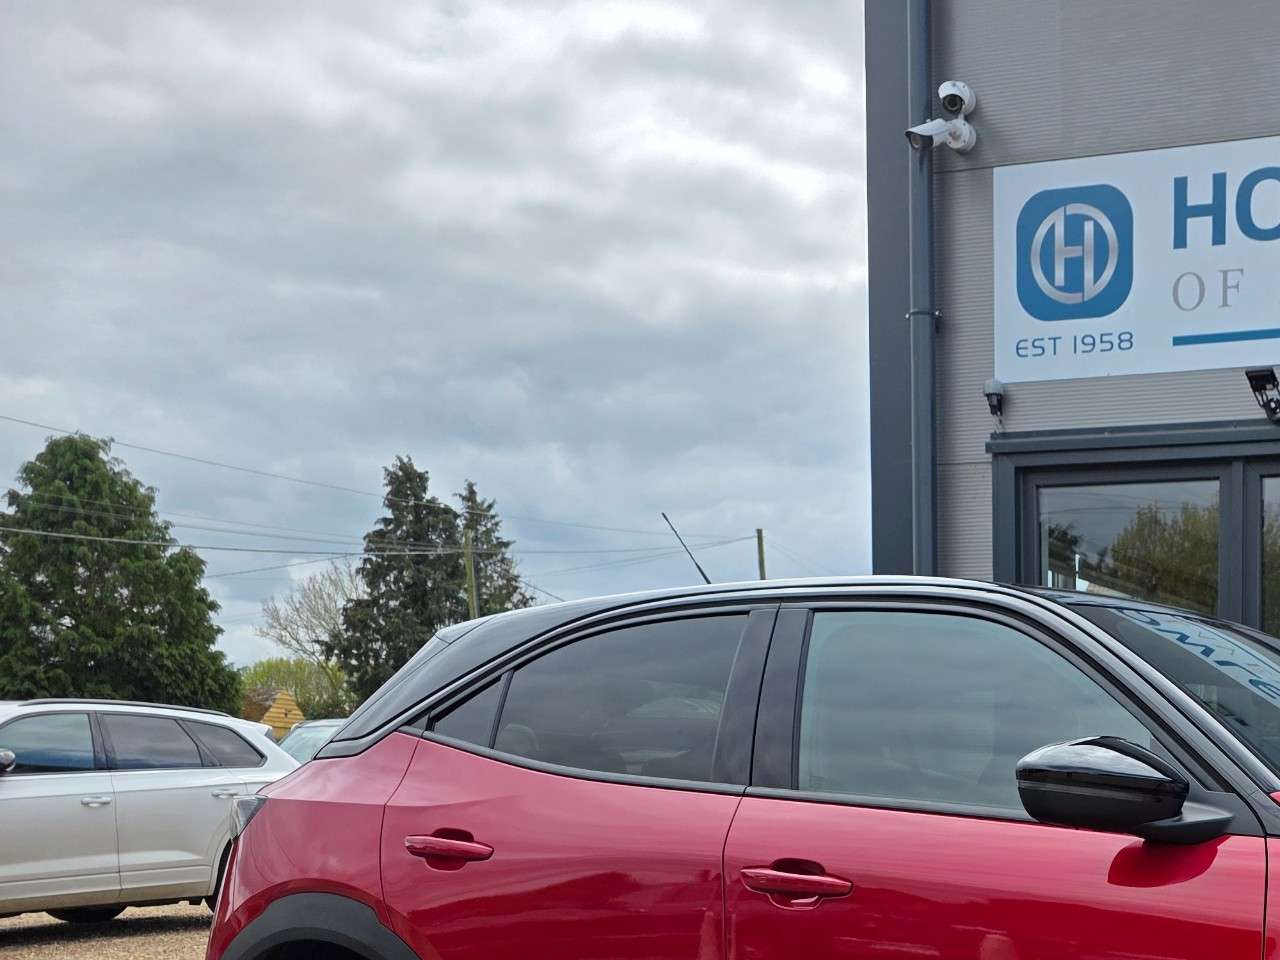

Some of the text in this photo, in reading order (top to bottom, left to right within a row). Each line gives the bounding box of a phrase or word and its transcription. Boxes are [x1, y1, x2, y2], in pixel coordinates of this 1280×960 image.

[1171, 267, 1245, 312] OF
[1016, 331, 1134, 358] EST 1958
